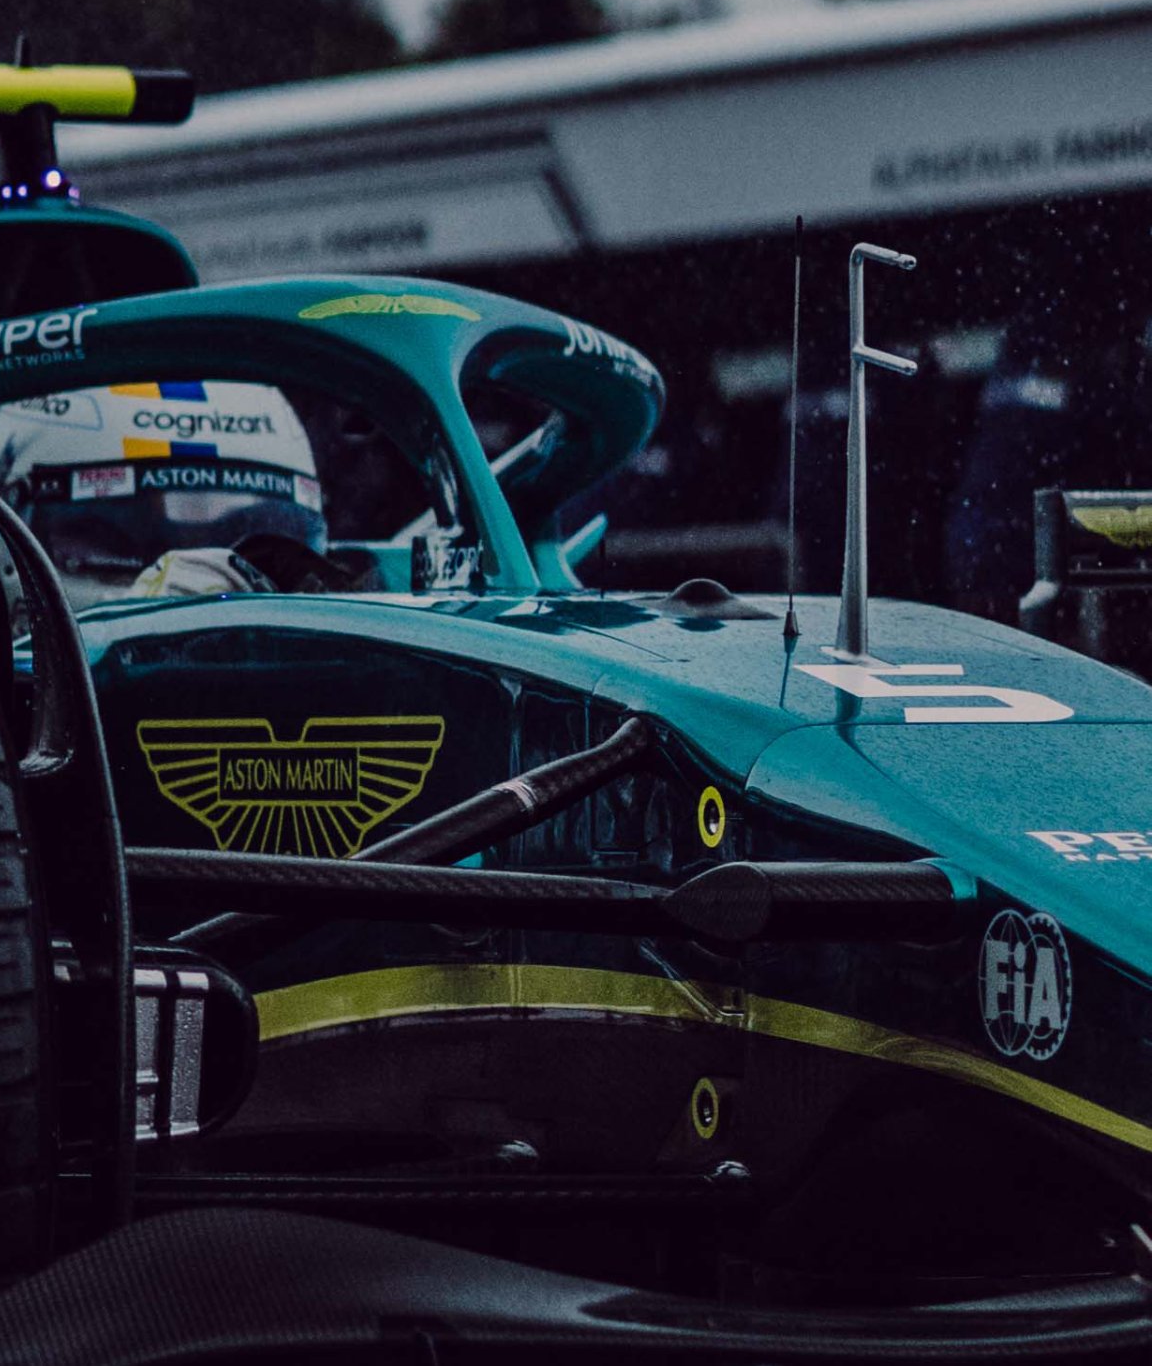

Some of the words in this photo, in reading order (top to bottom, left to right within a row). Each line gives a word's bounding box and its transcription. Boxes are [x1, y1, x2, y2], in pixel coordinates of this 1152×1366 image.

[141, 469, 216, 488] ASTON
[223, 469, 293, 493] MARTIN
[792, 664, 1075, 723] 5
[224, 757, 281, 791] ASTON
[285, 757, 353, 791] MARTIN
[1024, 830, 1152, 852] PE
